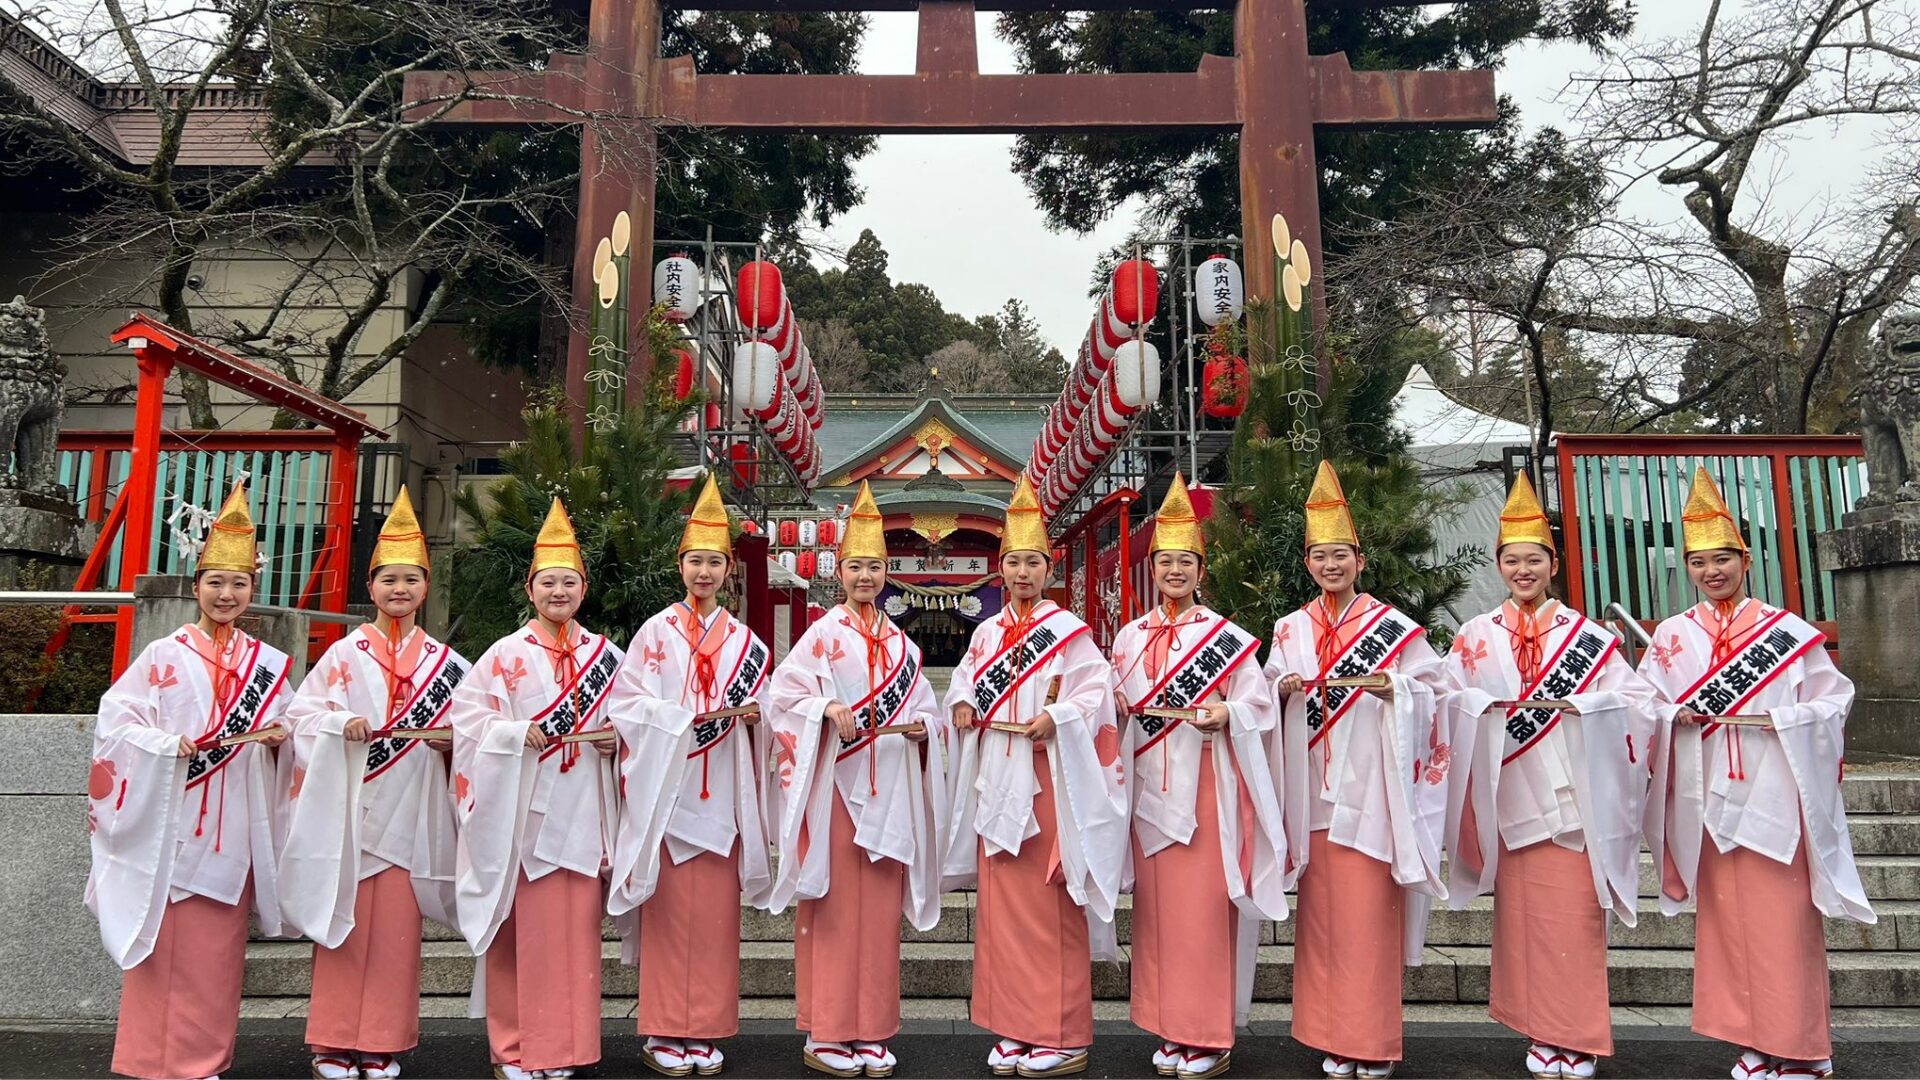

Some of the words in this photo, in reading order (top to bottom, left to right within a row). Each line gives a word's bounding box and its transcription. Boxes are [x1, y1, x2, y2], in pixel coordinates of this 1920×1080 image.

[665, 261, 683, 308] 社内安全
[1212, 261, 1232, 315] 家内安全
